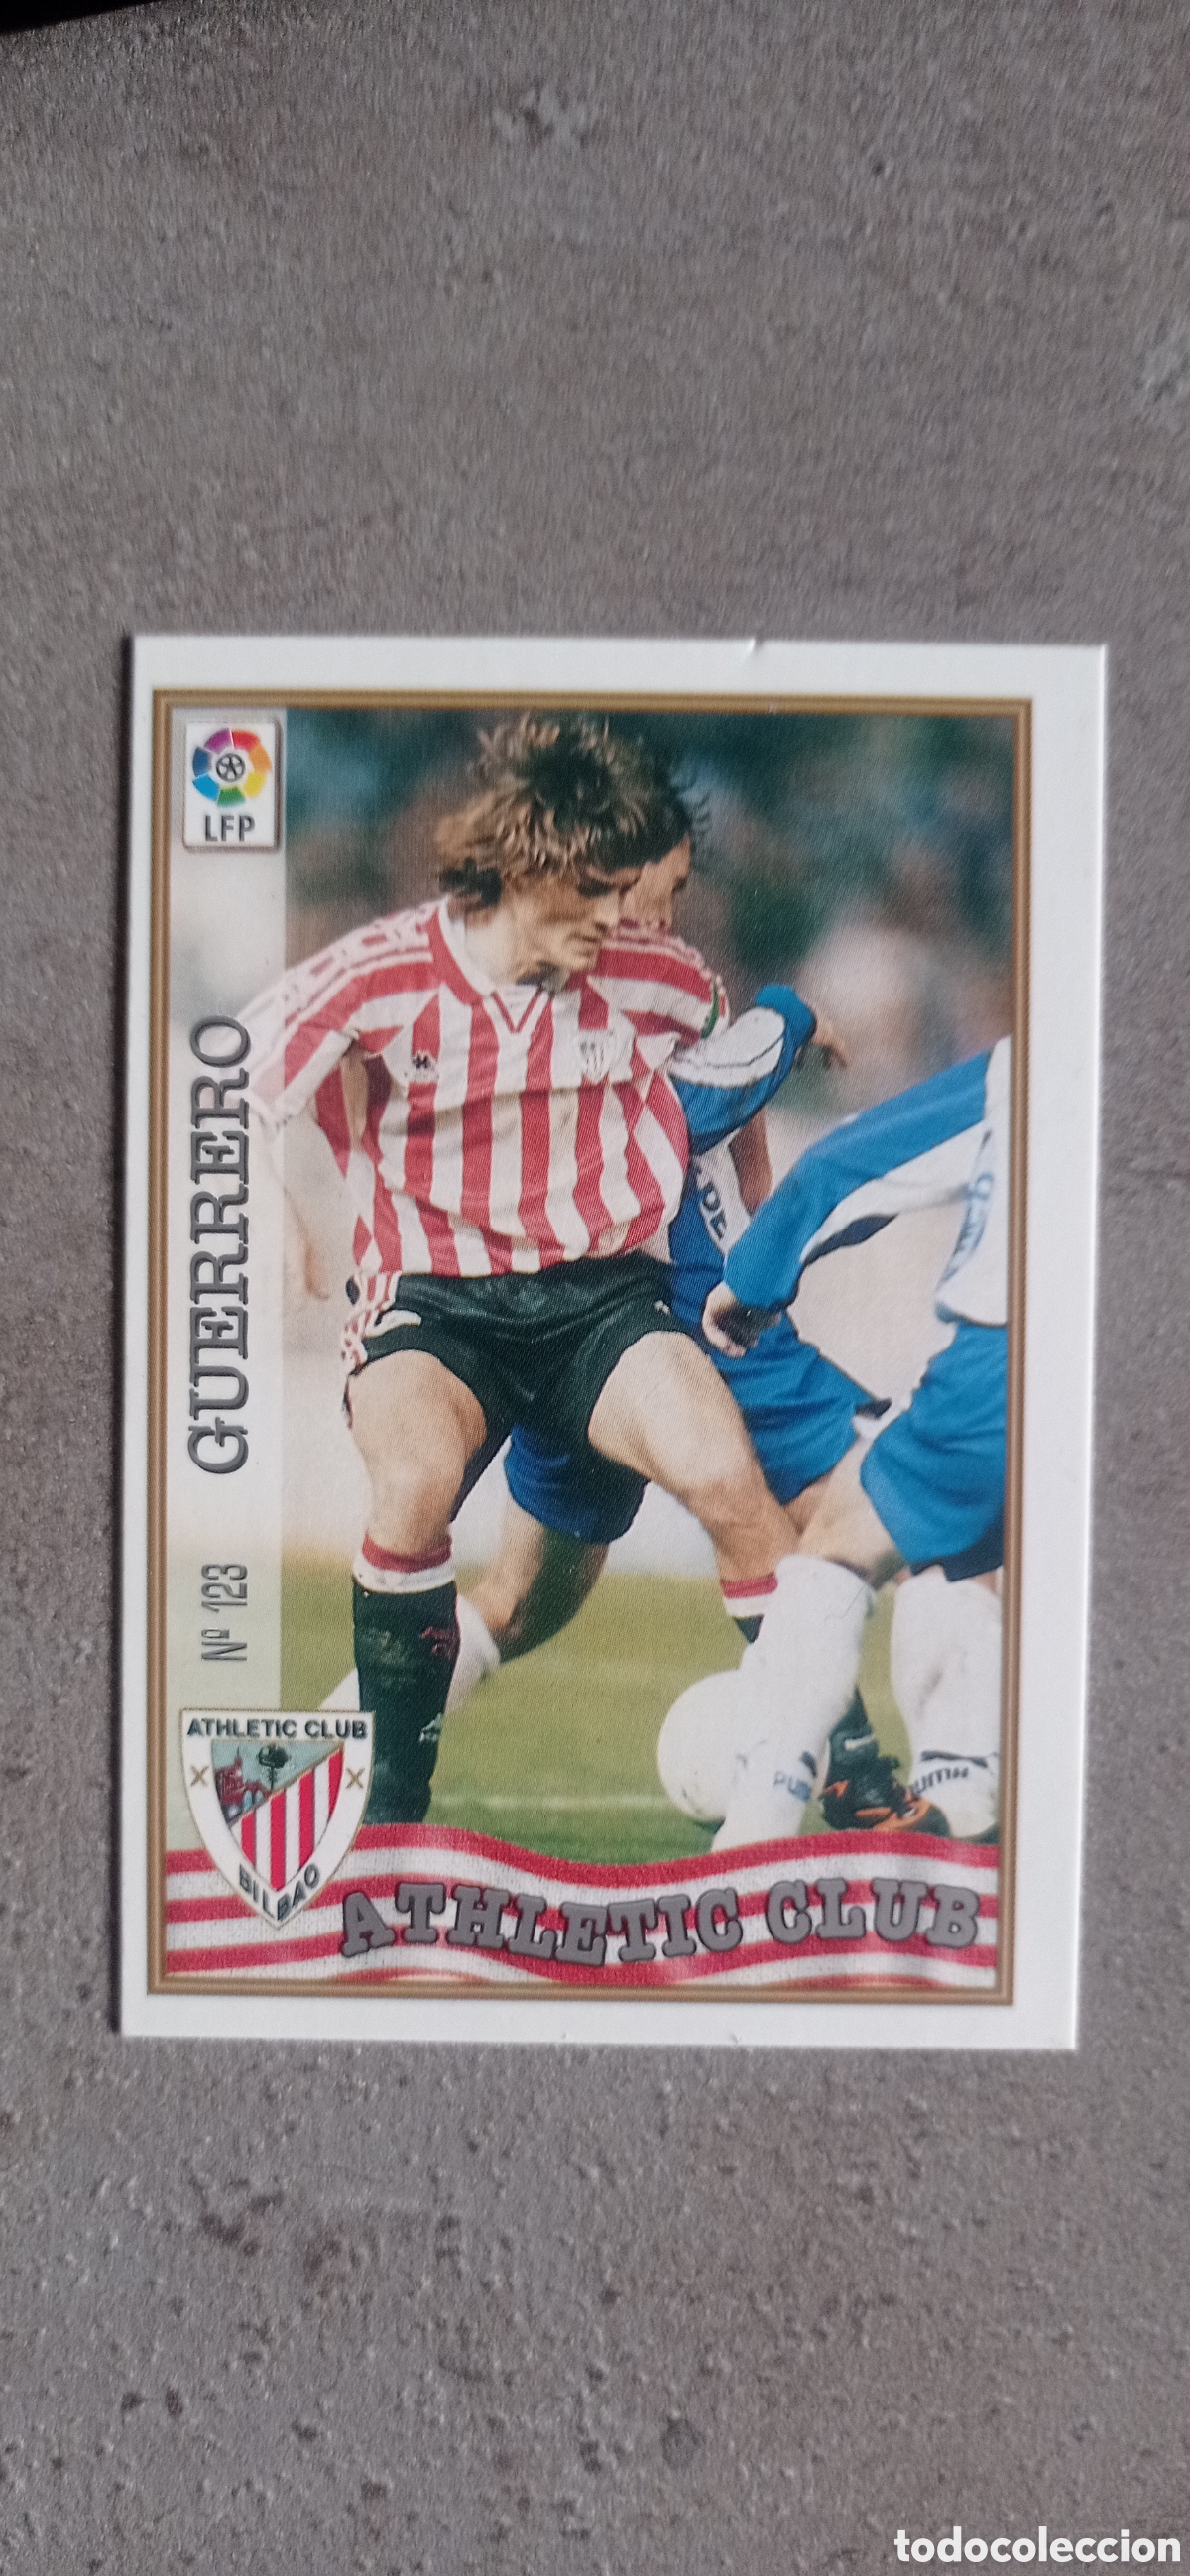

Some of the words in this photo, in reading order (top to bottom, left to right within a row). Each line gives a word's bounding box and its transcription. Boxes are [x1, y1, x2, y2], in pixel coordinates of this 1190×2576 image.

[204, 814, 255, 843] LFP
[187, 1014, 251, 1474] GUERRERO
[201, 1563, 248, 1614] 123
[187, 1718, 297, 1737] ATHLETIC
[304, 1719, 367, 1739] CLUB
[239, 1863, 319, 1922] BILBAO
[341, 1882, 743, 1967] ATHLETIC
[764, 1877, 980, 1949] CLUB
